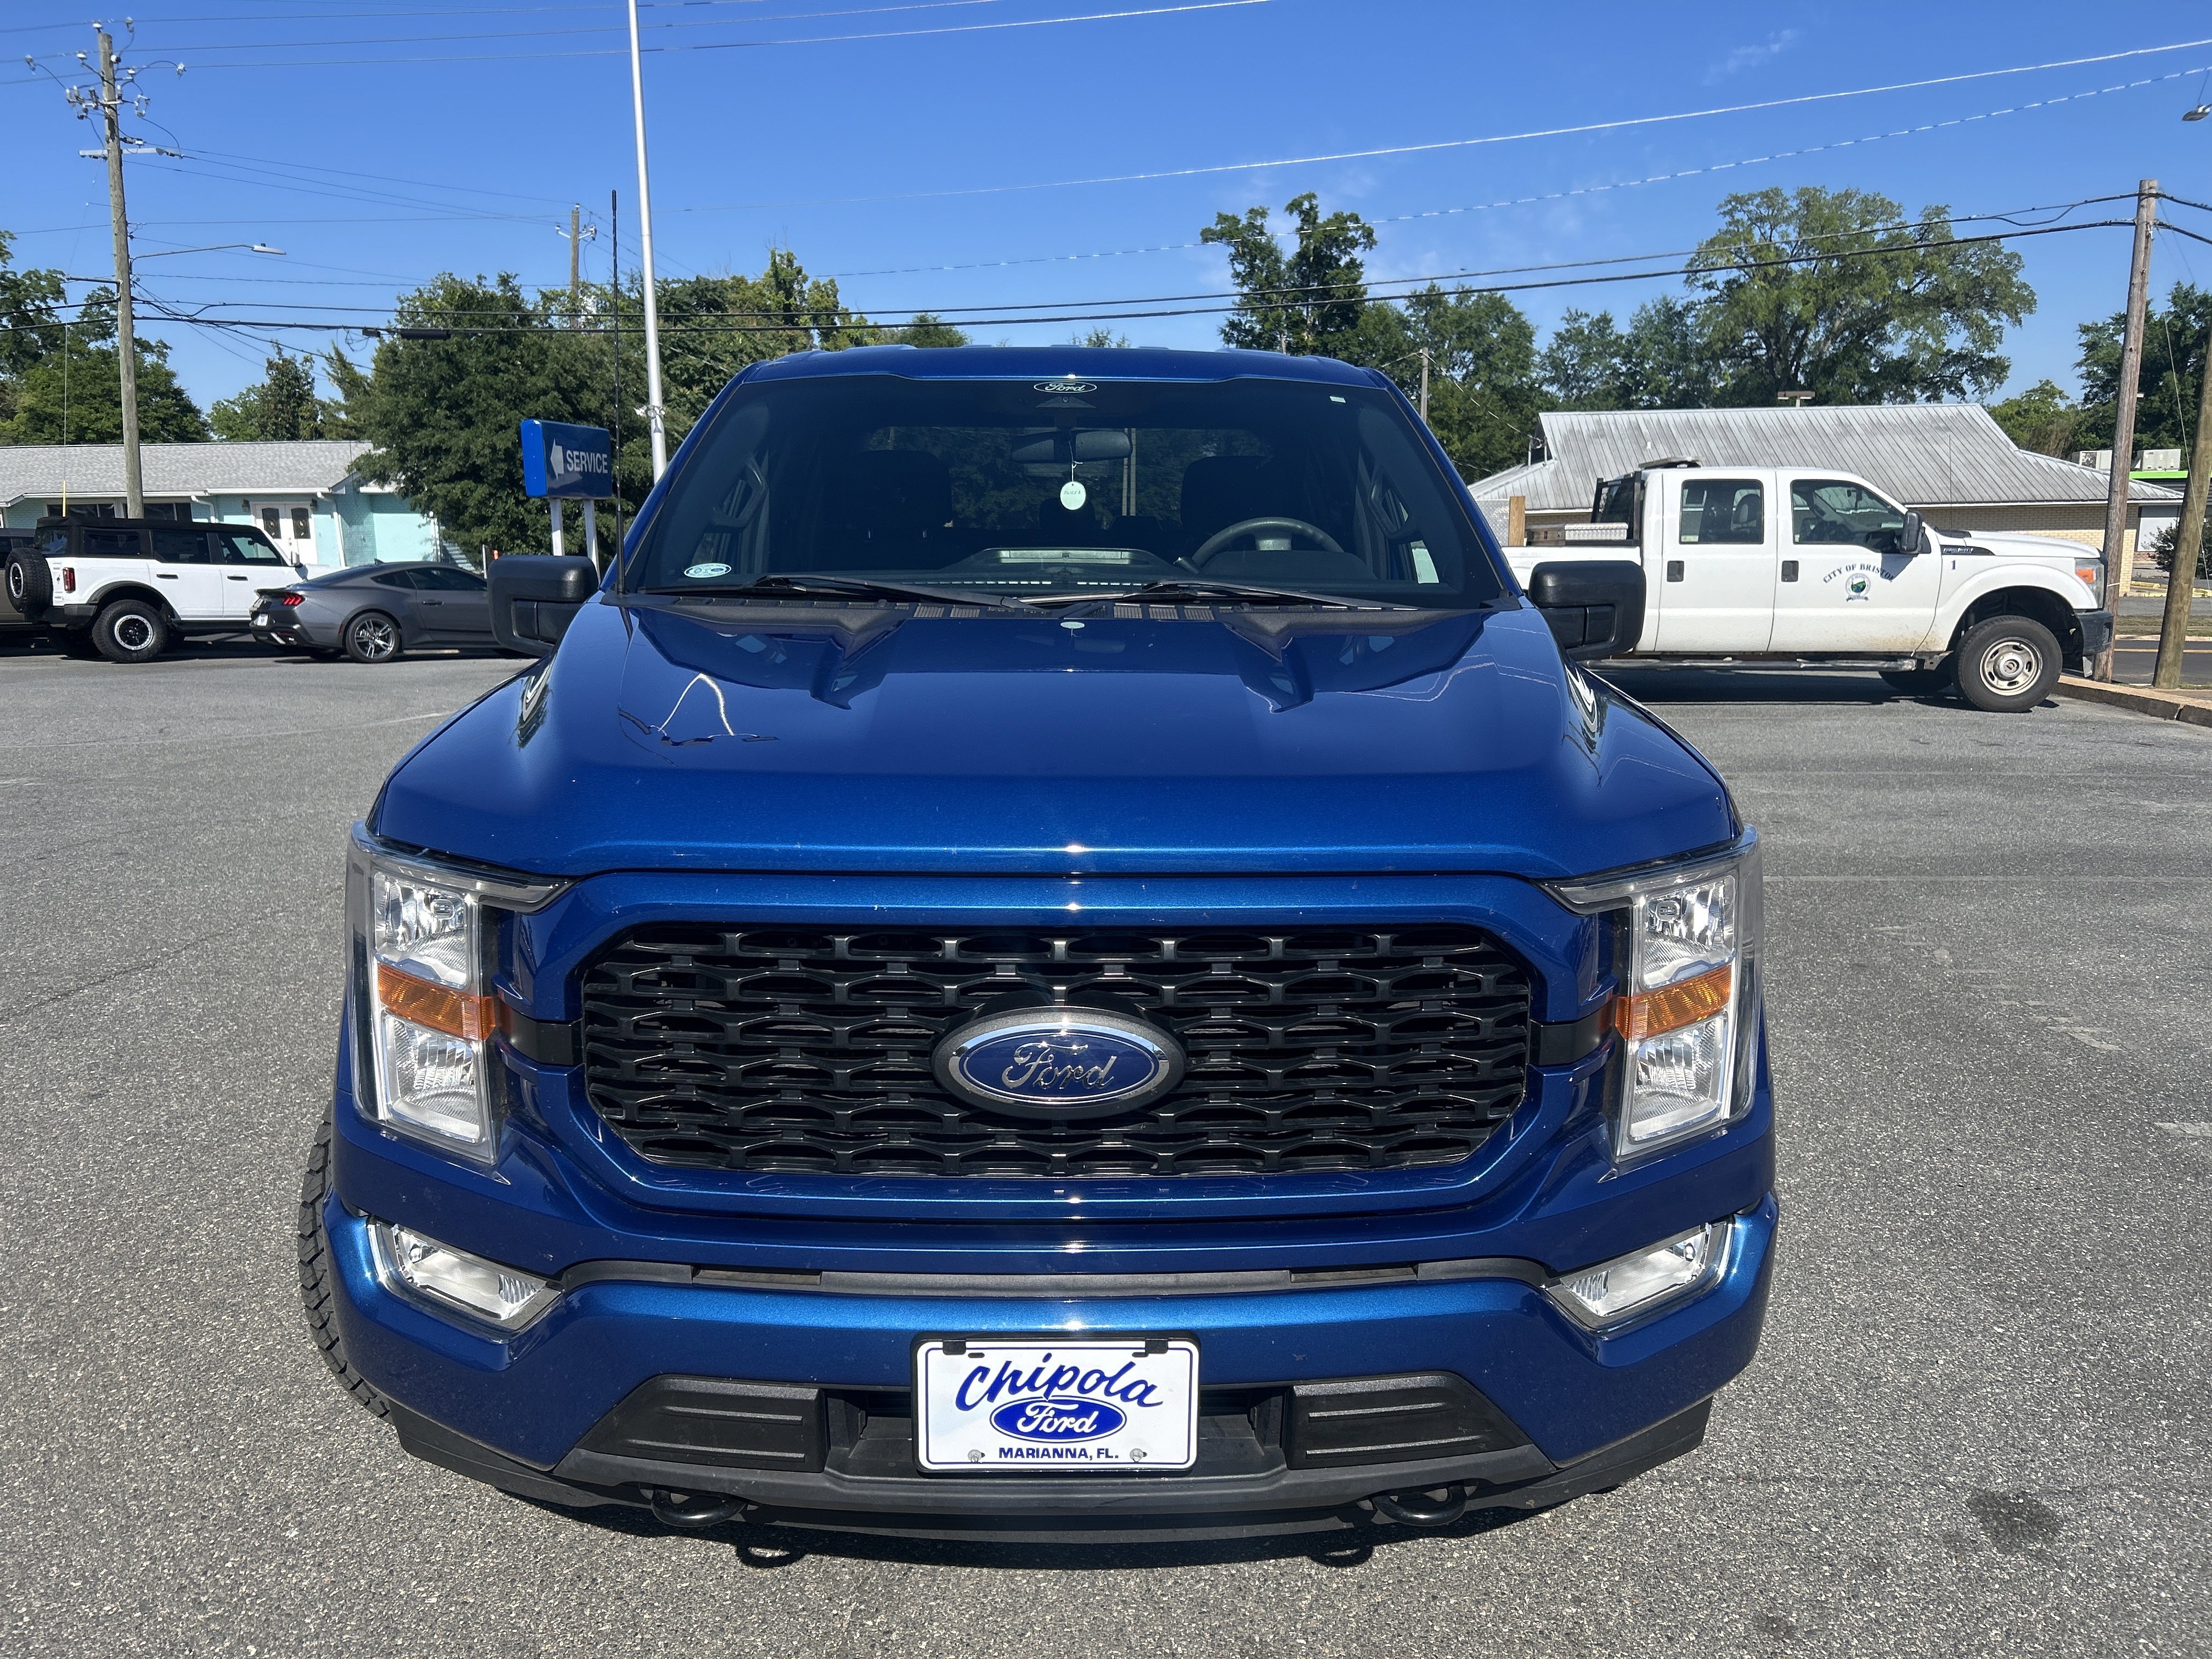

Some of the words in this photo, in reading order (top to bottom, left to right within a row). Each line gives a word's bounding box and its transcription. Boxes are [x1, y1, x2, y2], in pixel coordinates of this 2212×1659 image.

[1045, 382, 1086, 392] Ford
[566, 450, 608, 473] SERVICE
[1822, 567, 1842, 584] CITY
[1845, 563, 1857, 572] OF
[1001, 1042, 1118, 1089] Ford
[955, 1352, 1163, 1412] Chipola
[1017, 1401, 1099, 1434] Ford
[998, 1447, 1093, 1462] MARIANNA,
[1097, 1448, 1119, 1459] FL.
